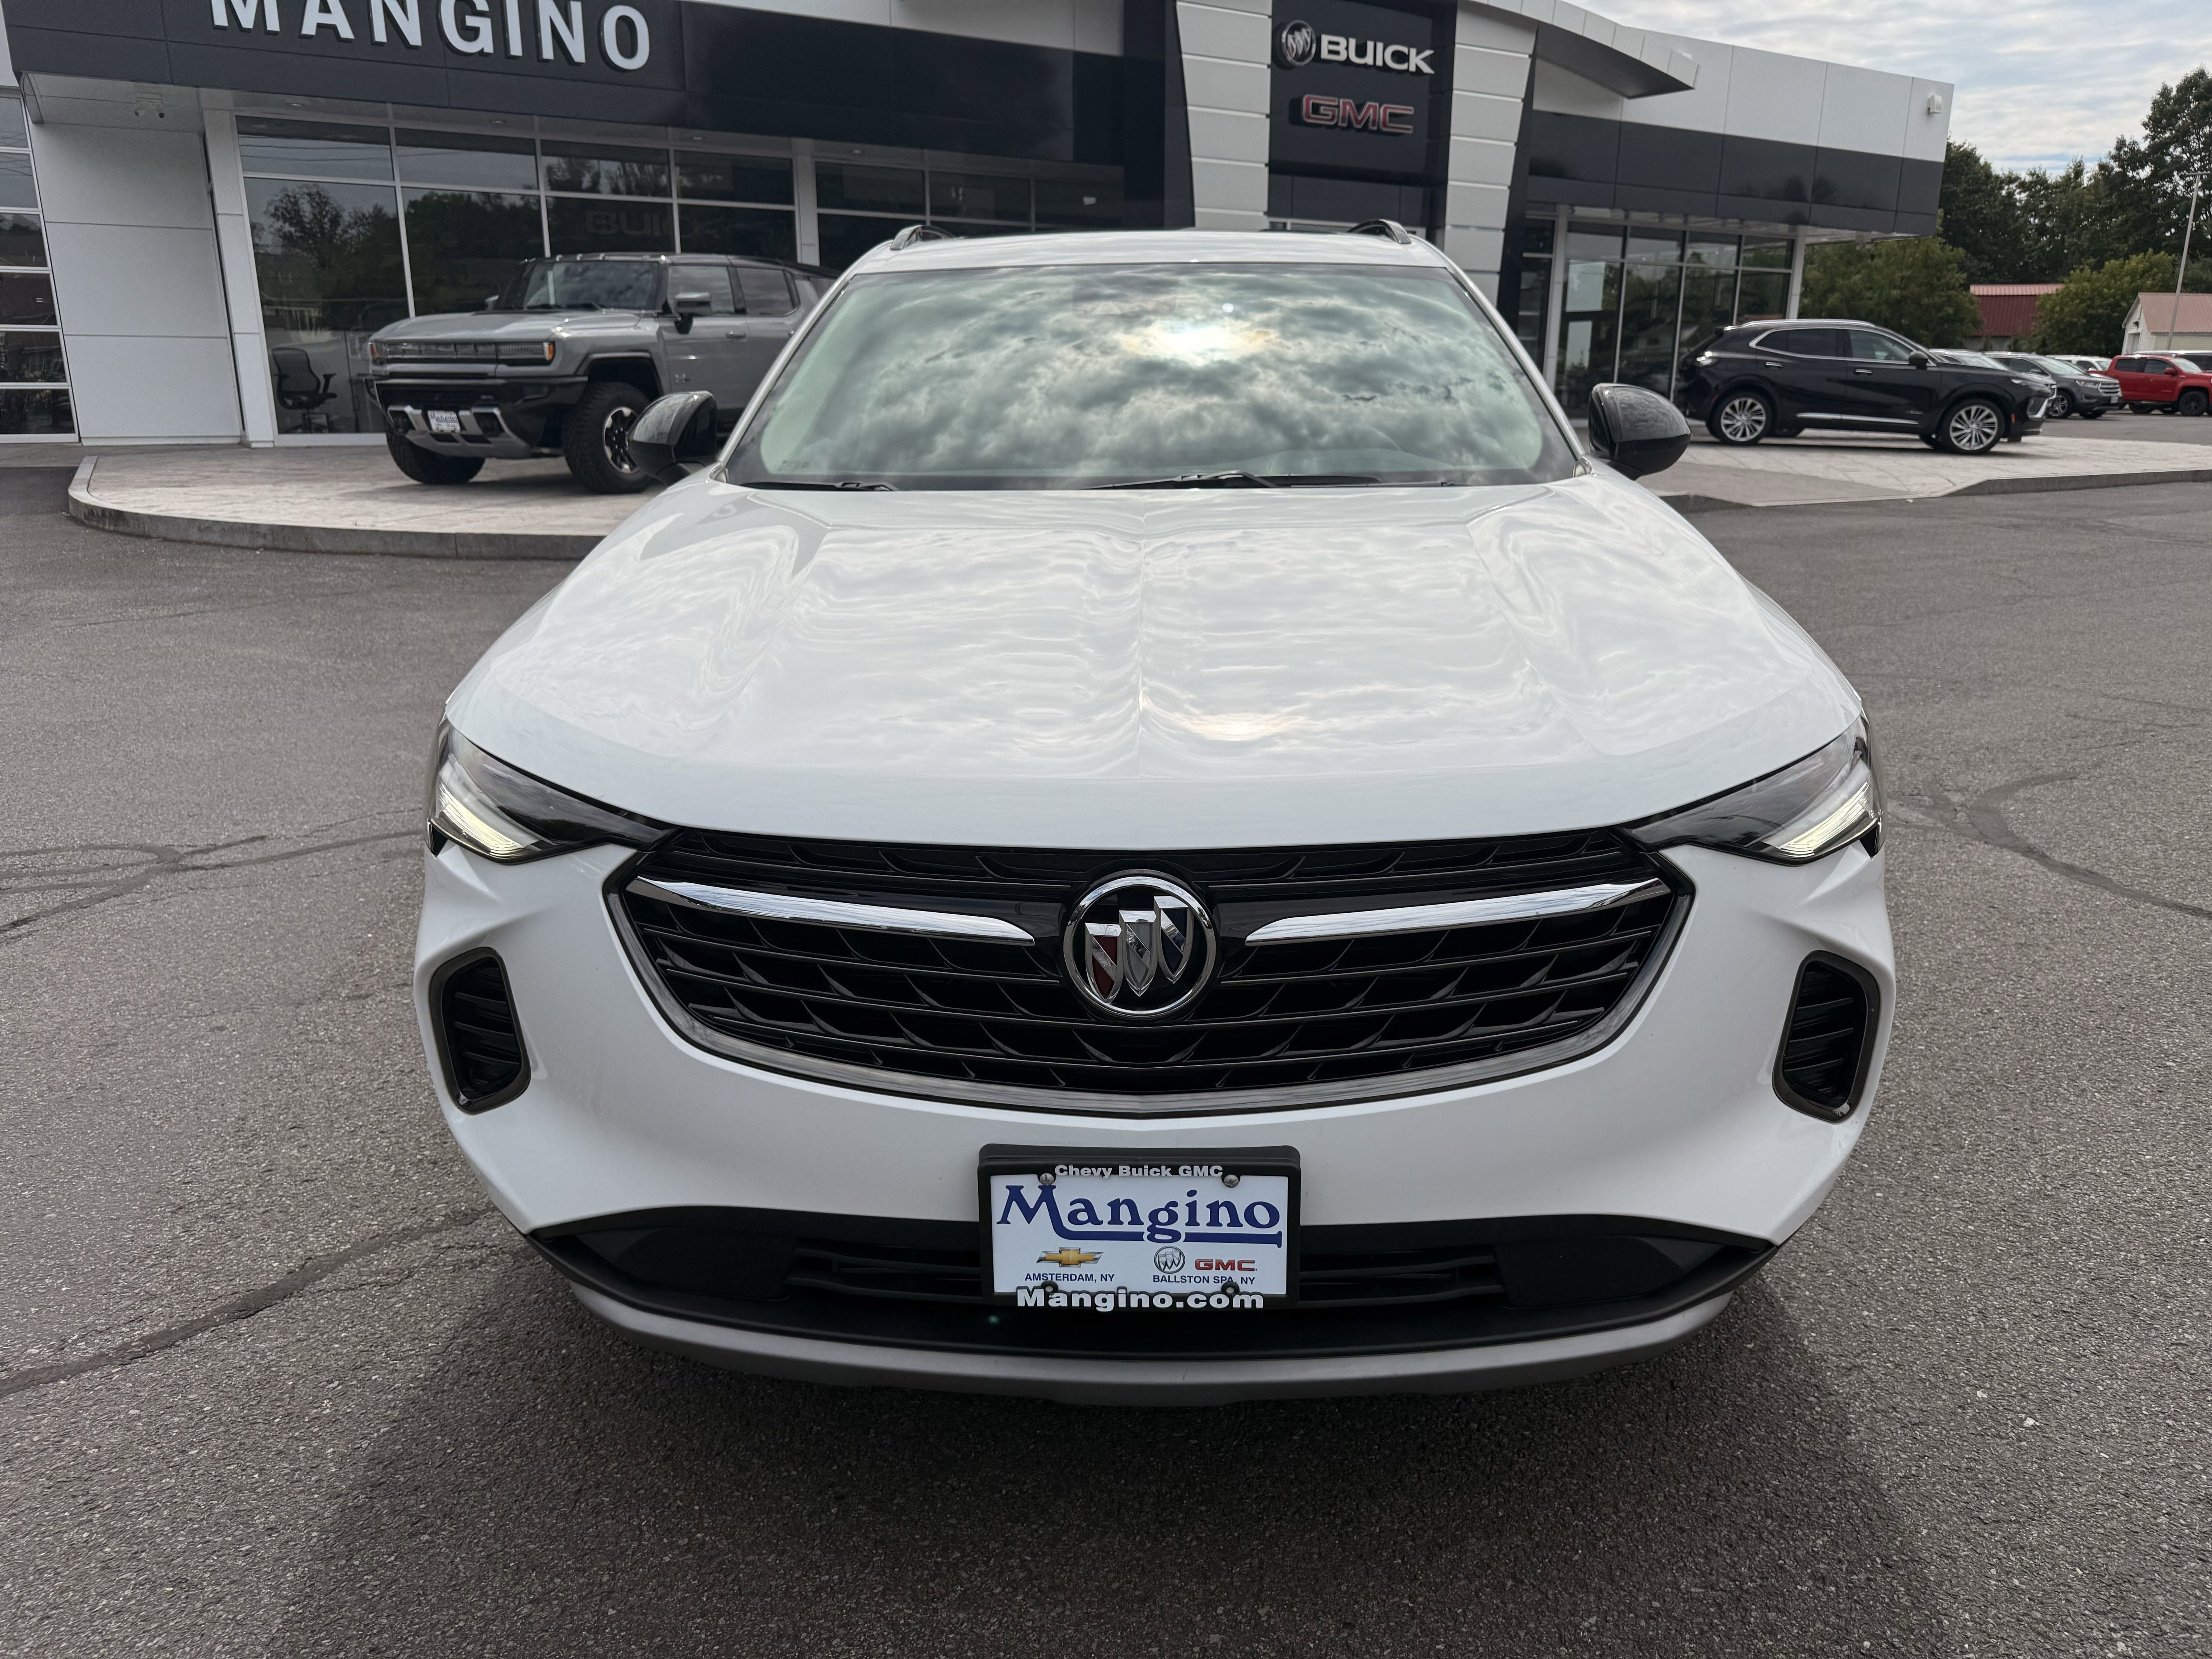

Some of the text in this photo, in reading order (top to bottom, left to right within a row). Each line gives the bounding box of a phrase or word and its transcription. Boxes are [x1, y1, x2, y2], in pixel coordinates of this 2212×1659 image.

[211, 0, 650, 71] MANGINO
[1321, 34, 1435, 74] BUICK
[1303, 94, 1414, 134] GMC
[1055, 1165, 1223, 1178] Chevy Buick GMC
[996, 1185, 1282, 1248] Mangino
[1025, 1273, 1097, 1283] AMSTERDAM,
[1153, 1275, 1209, 1284] BALLSTON
[1017, 1288, 1263, 1312] Mangino.com
